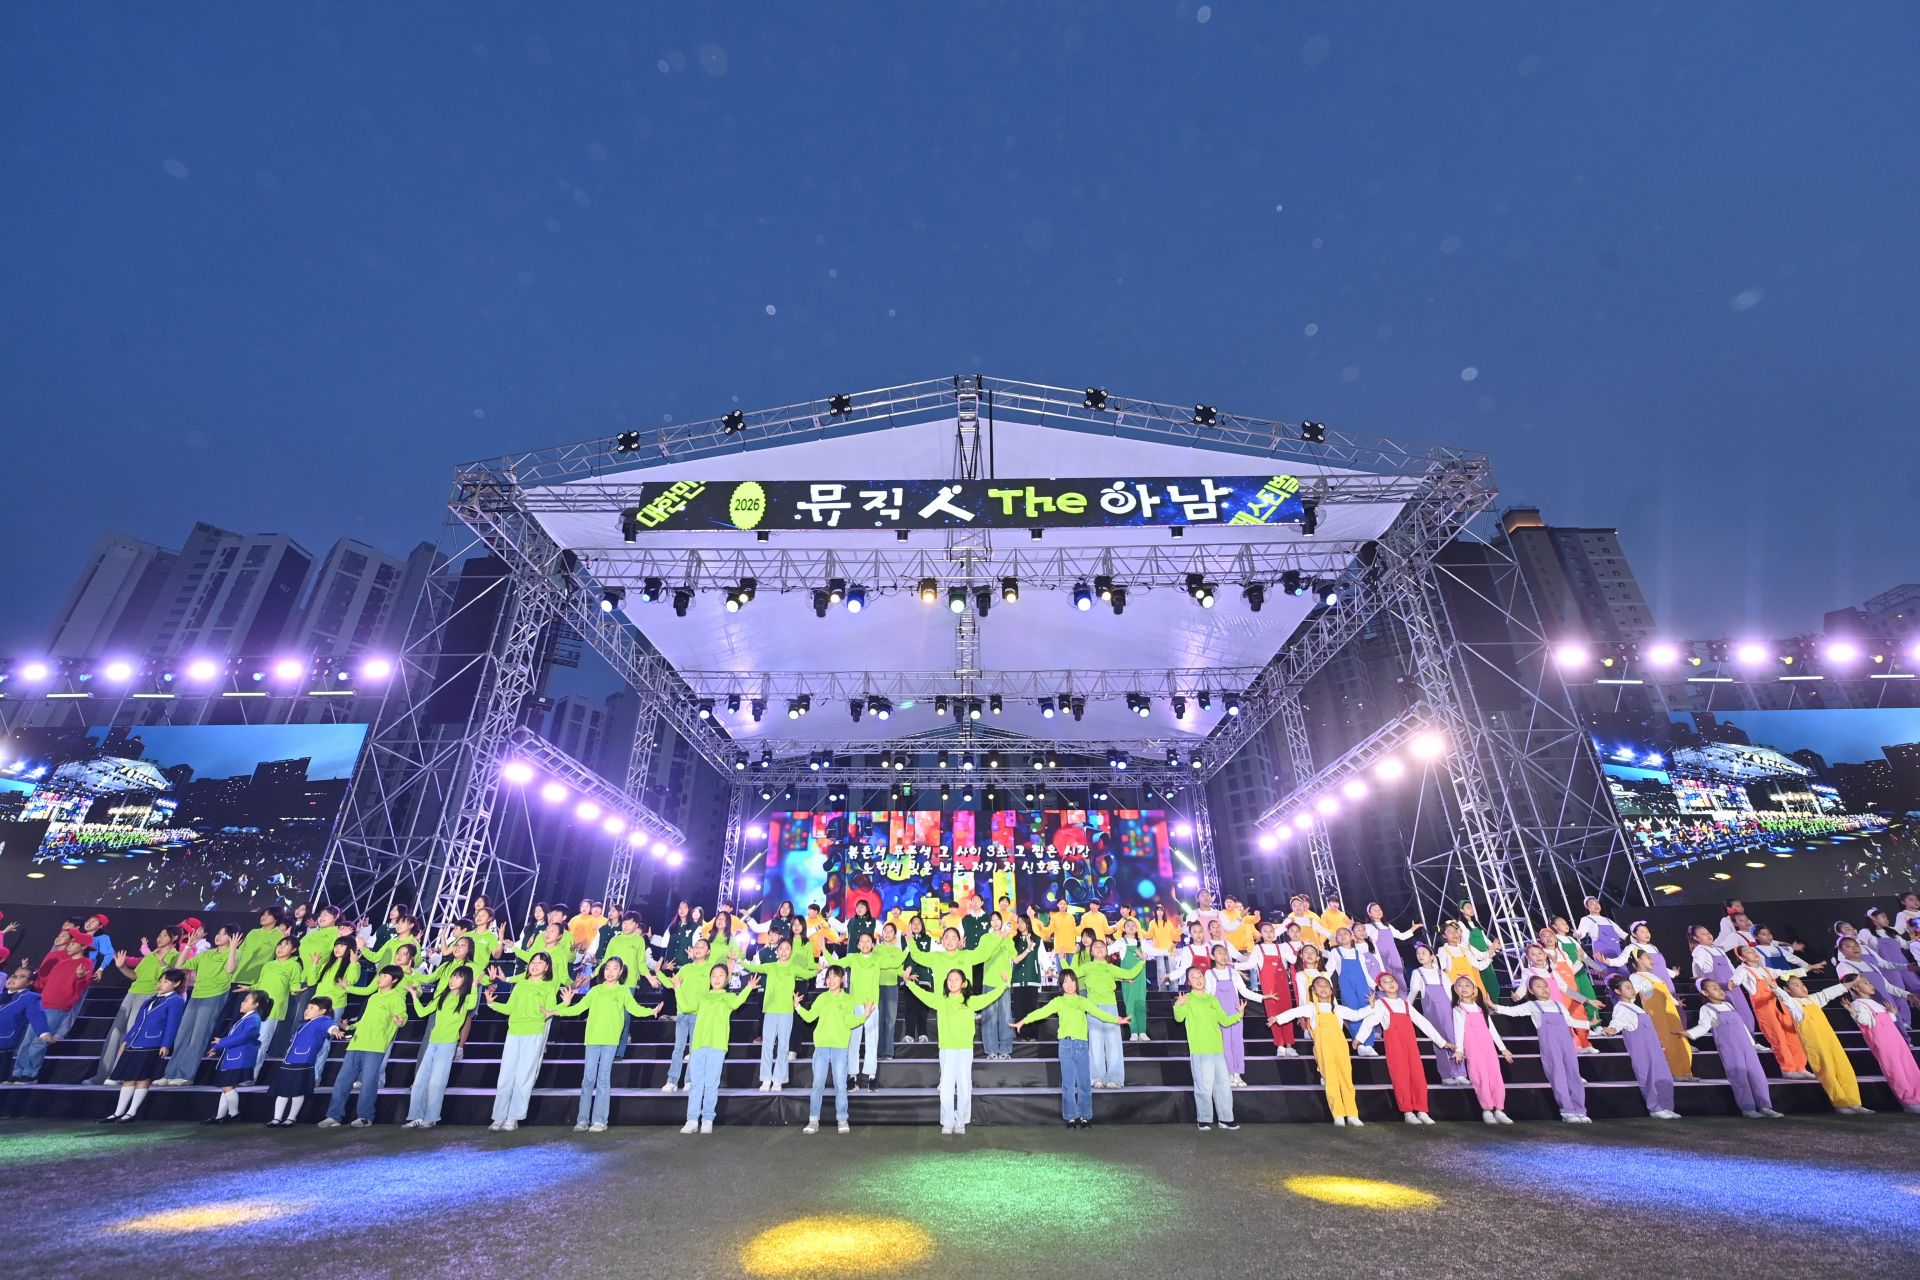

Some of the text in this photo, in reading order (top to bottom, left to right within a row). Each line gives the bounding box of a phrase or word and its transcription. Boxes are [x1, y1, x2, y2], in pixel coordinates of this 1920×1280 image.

[636, 481, 707, 527] 대한민
[734, 498, 760, 511] 2026
[797, 484, 903, 527] 뮤직
[987, 486, 1088, 518] The
[848, 844, 1090, 859] 붉은색 푸른색 그 사이 3초 그 짧은 시간
[862, 862, 902, 876] 노란색
[939, 861, 965, 874] 내는
[972, 861, 998, 873] 저기
[1003, 862, 1016, 873] 저
[1021, 861, 1075, 875] 신호등이
[980, 921, 989, 930] Y
[919, 941, 928, 949] Y
